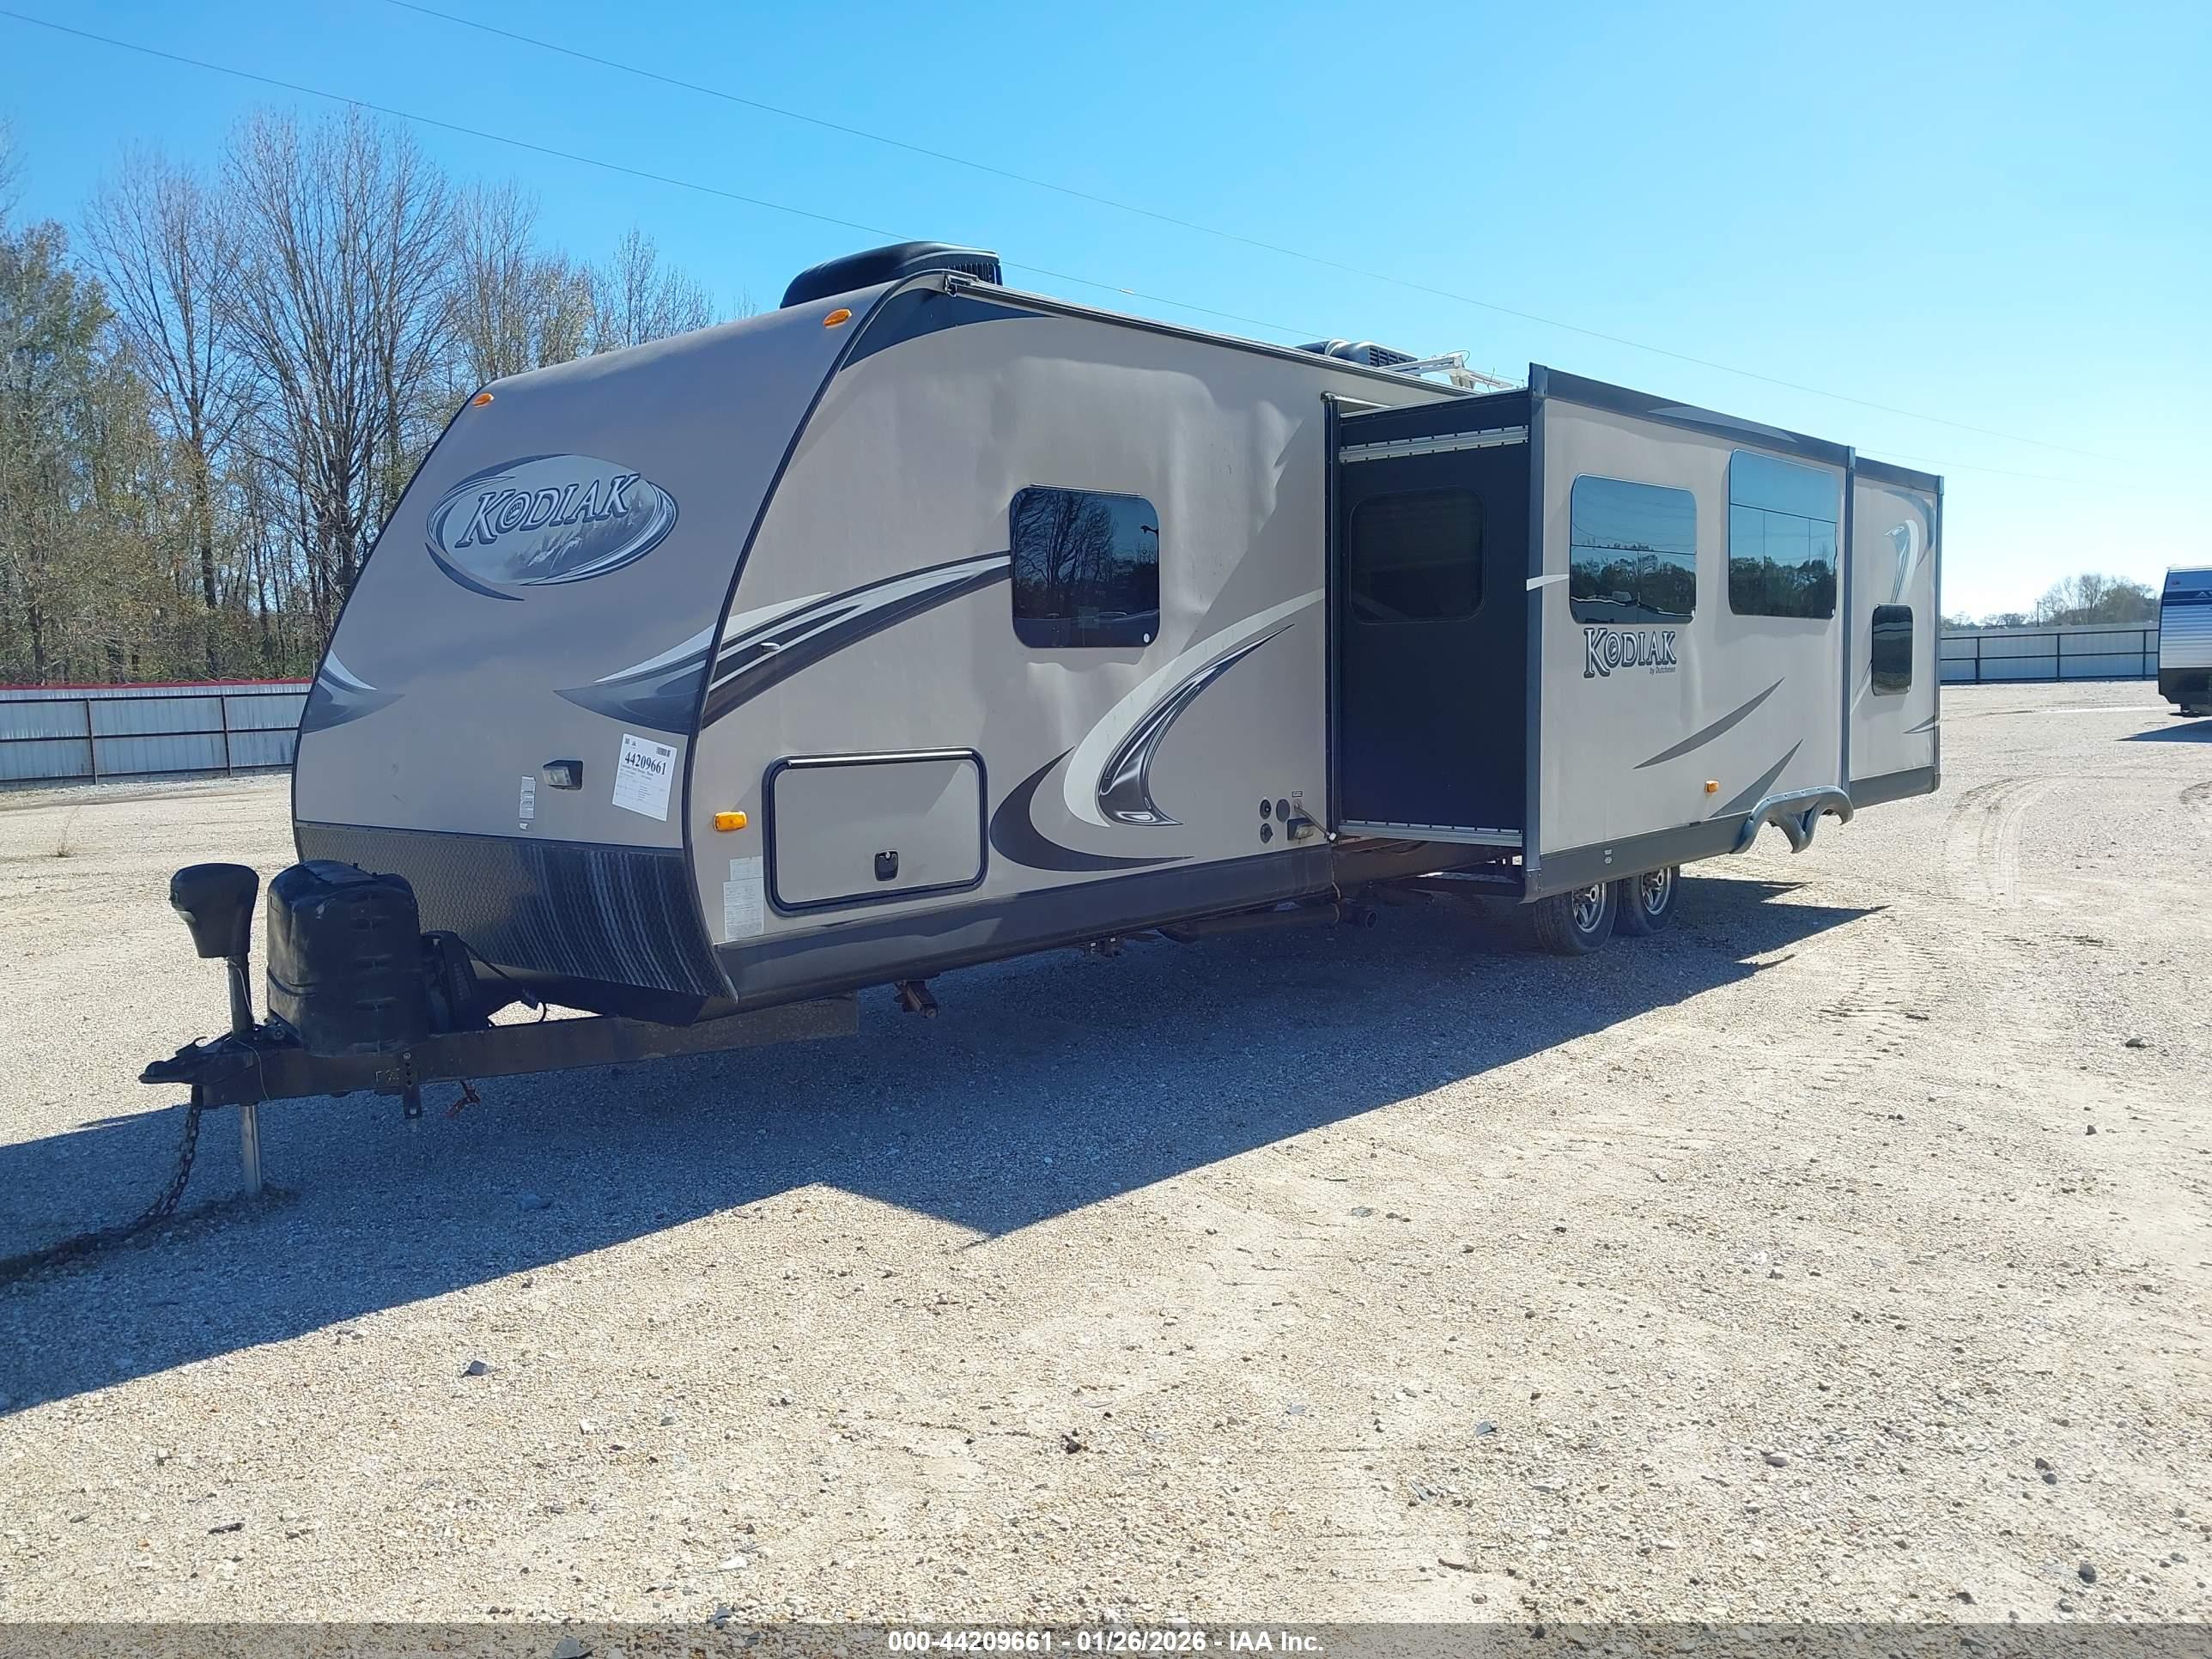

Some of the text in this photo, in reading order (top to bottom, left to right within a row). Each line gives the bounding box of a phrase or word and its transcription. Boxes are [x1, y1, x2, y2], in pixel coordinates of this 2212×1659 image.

[454, 472, 641, 548] KODIAK
[1583, 628, 1677, 678] KODIAK
[624, 751, 666, 775] 44209661
